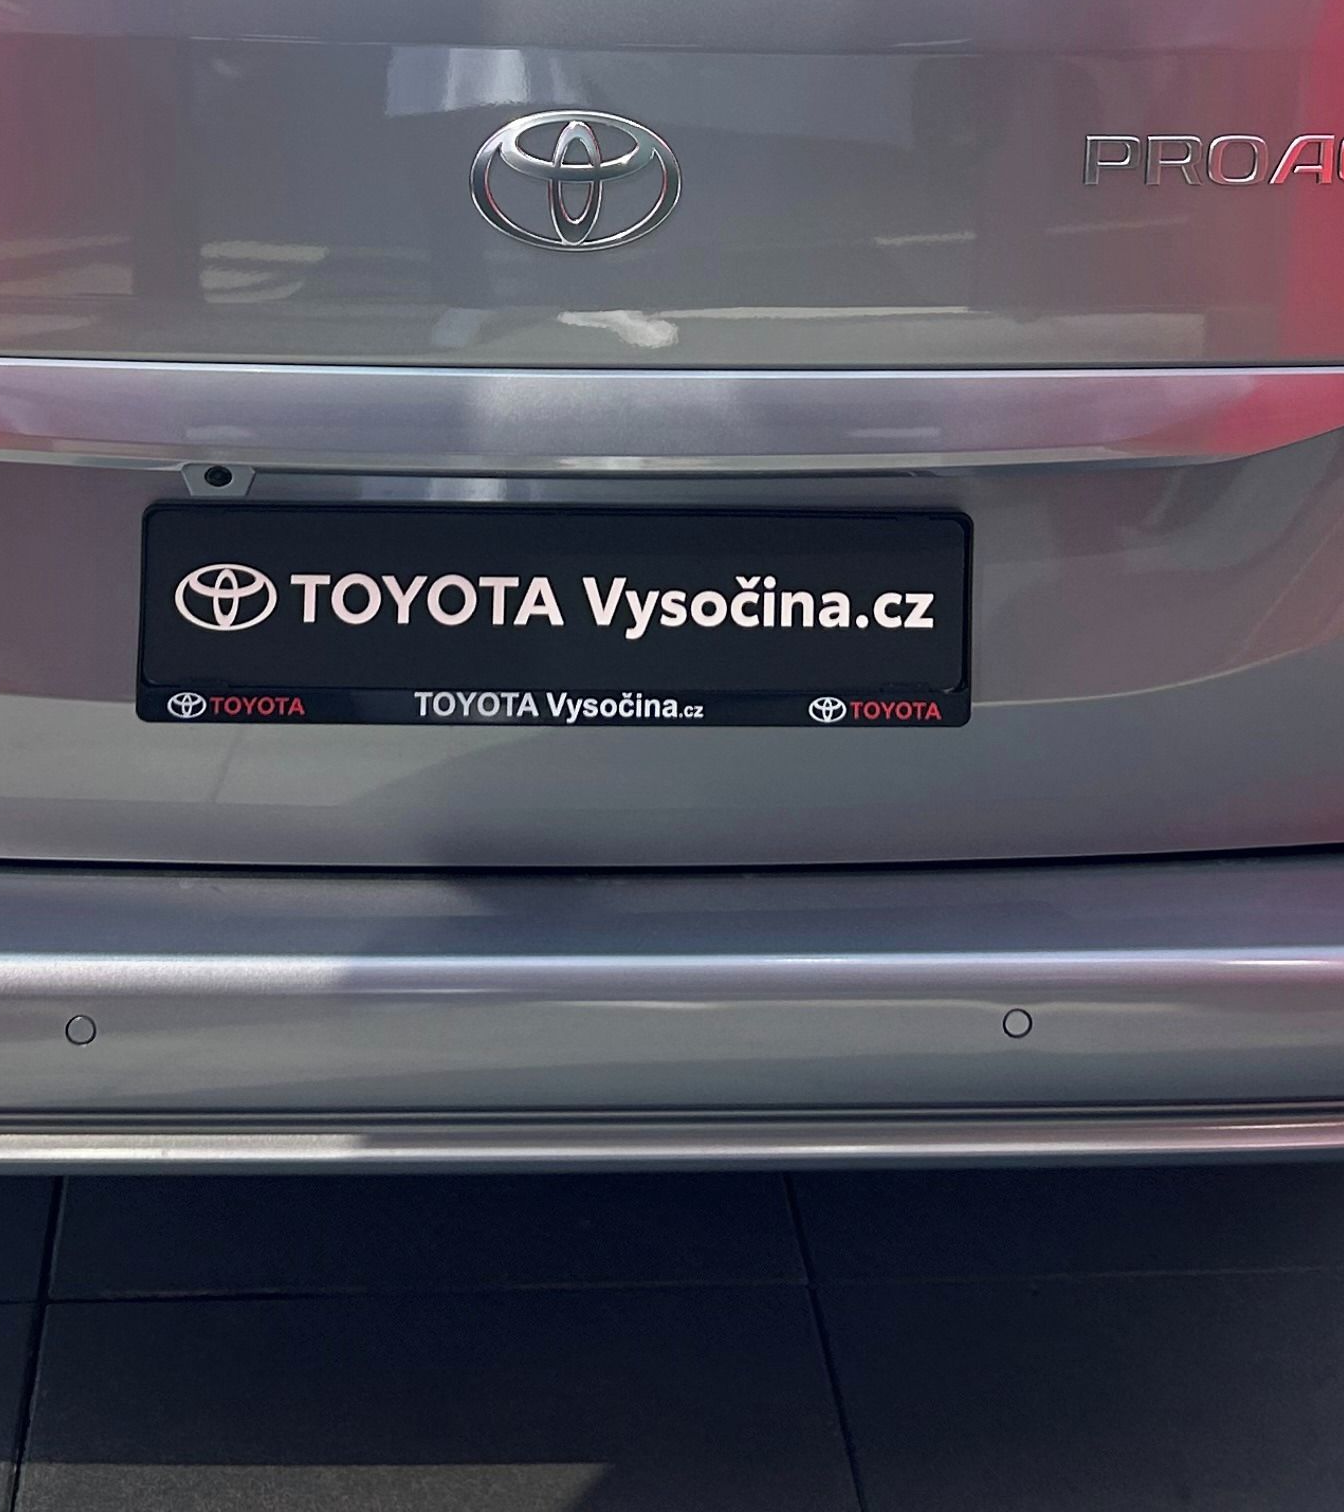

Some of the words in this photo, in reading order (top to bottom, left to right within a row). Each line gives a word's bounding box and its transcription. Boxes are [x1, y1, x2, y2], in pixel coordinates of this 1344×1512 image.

[291, 572, 564, 627] TOYOTA
[582, 575, 935, 640] Vysočina.cz
[210, 695, 306, 716] TOYOTA
[413, 690, 538, 718] TOYOTA
[546, 692, 705, 724] Vysočina.cz
[849, 700, 943, 720] TOYOTA
